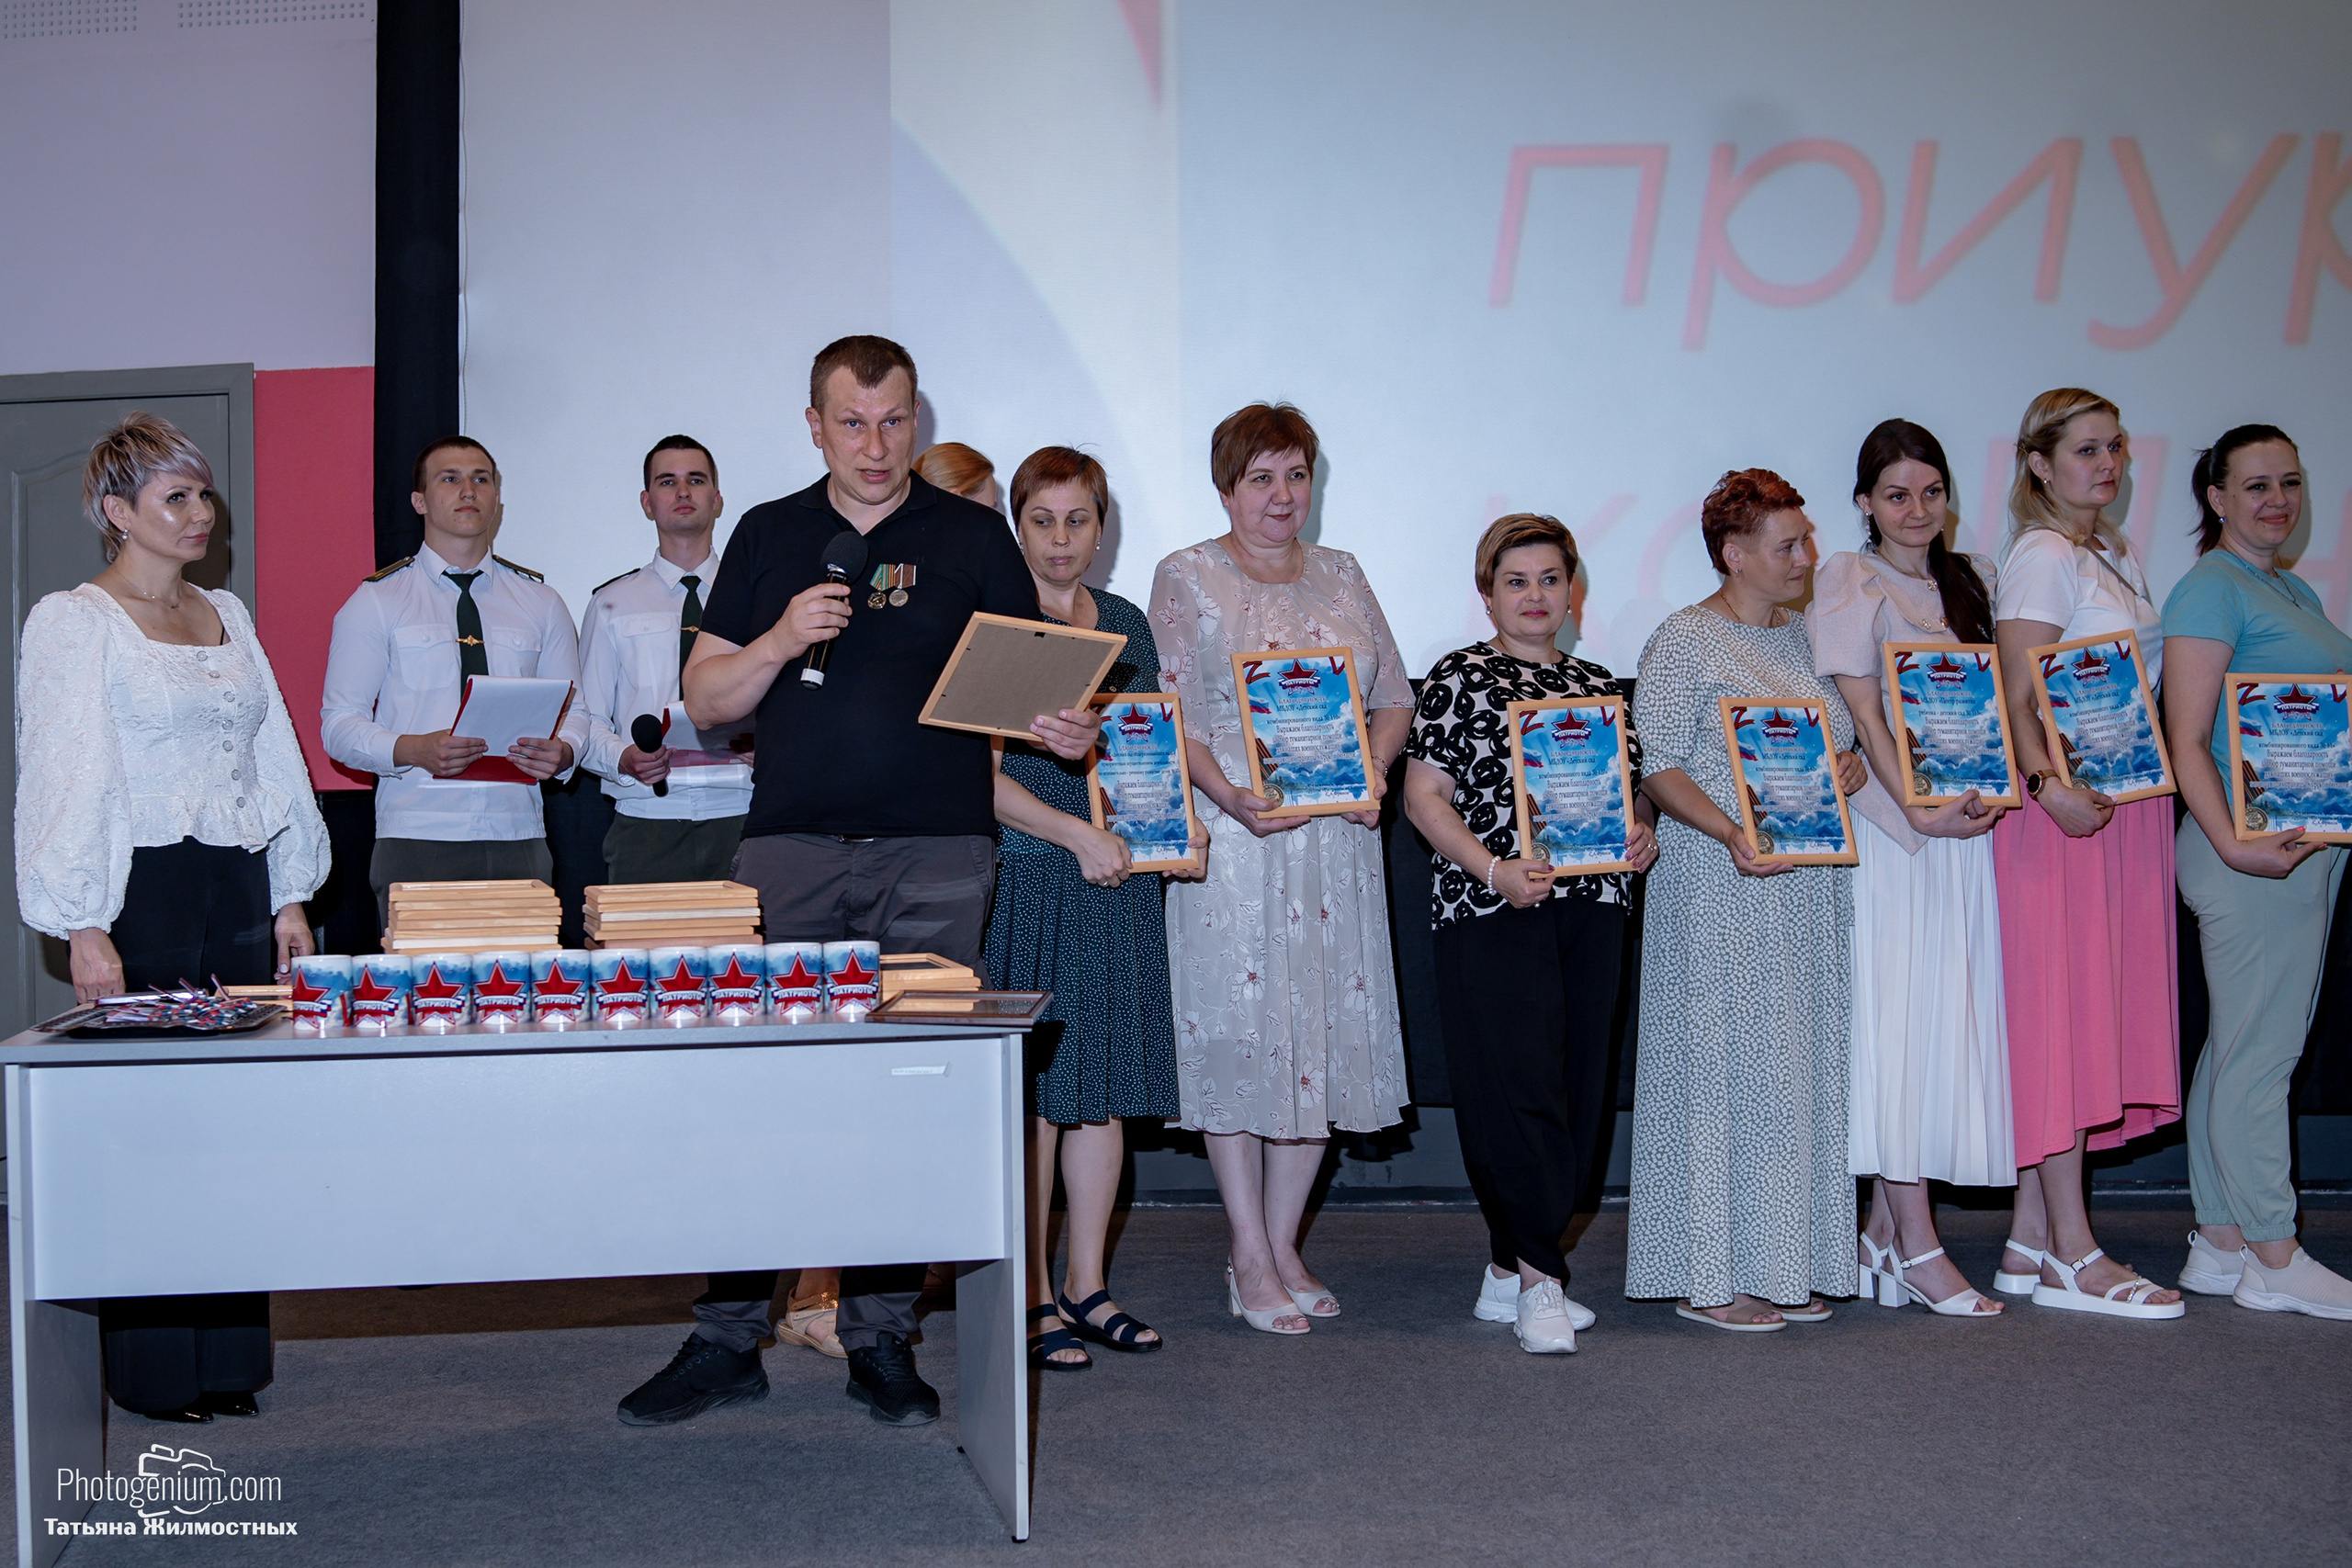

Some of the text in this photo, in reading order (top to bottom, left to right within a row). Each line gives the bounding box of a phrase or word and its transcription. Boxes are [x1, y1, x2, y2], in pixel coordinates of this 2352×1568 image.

[1266, 716, 1312, 725] комбинированного
[1276, 723, 1335, 735] Выражаем благодарность
[2267, 750, 2329, 760] Выражаем благодарность
[716, 991, 756, 999] ПАТРИОТЫ
[778, 990, 819, 998] ПАТРИОТЫ
[833, 987, 874, 995] ПАТРИОТЫ
[537, 998, 579, 1006] ПАТРИОТЫ
[603, 996, 643, 1004] ПАТРИОТЫ
[662, 994, 703, 1002] ПАТРИОТЫ
[417, 1000, 458, 1009] ПАТРИОТЫ
[480, 998, 520, 1007] ПАТРИОТЫ
